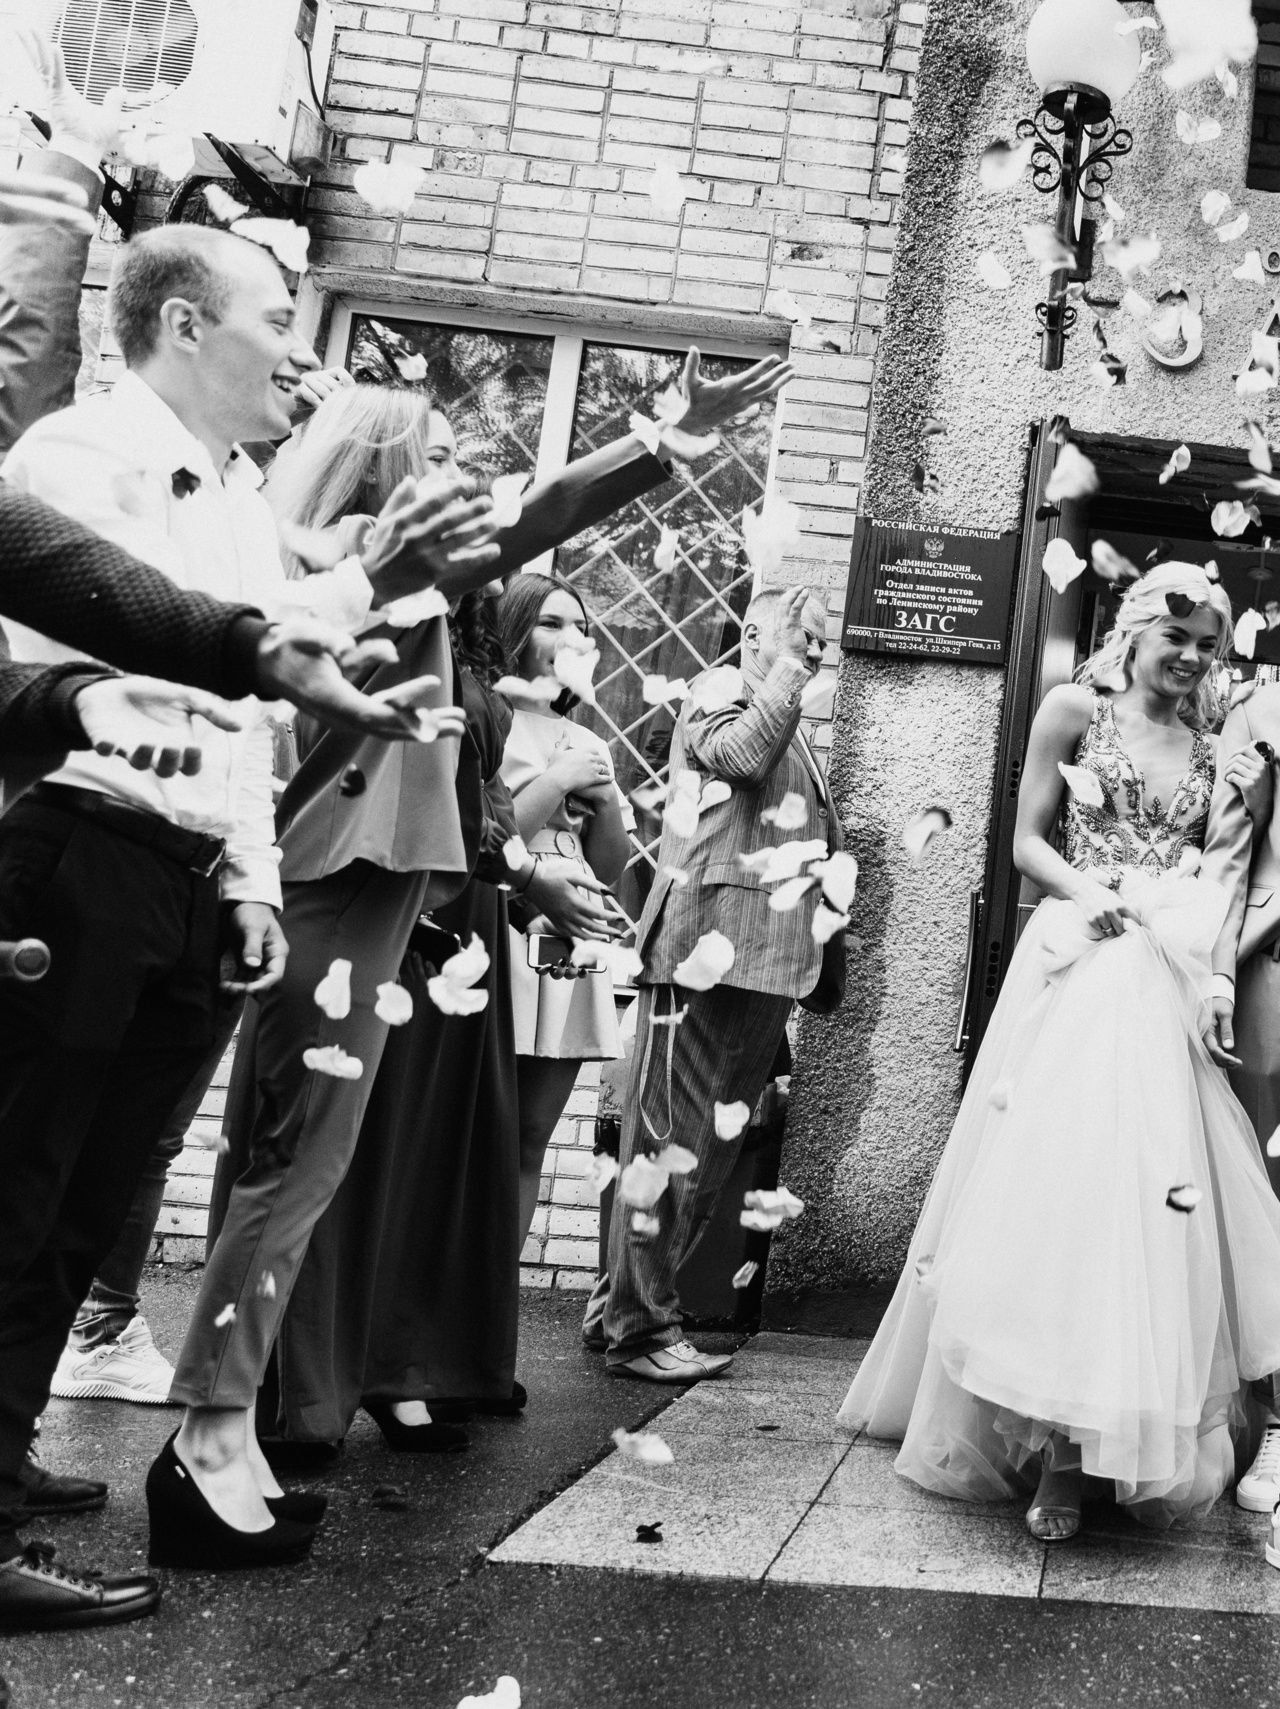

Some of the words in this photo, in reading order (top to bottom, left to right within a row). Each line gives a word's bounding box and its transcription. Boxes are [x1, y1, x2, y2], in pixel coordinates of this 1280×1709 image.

[871, 519, 940, 533] РОССИЙСКАЯ
[941, 526, 1001, 540] ФЕДЕРАЦИЯ
[880, 564, 912, 574] ГОРОДА
[914, 568, 983, 581] ВЛАДИВОСТОКА
[895, 559, 971, 573] АДМИНИСТРАЦИЯ
[886, 580, 913, 590] Отдел
[915, 584, 946, 593] записи
[948, 587, 974, 596] актов
[873, 589, 936, 600] гражданского
[938, 595, 983, 606] состояния
[889, 597, 945, 612] Ленинскому
[946, 605, 979, 616] району
[894, 610, 956, 633] ЗАГС
[846, 628, 873, 638] 690000,
[879, 631, 922, 642] Владивосток
[931, 645, 961, 655] 22-29-22
